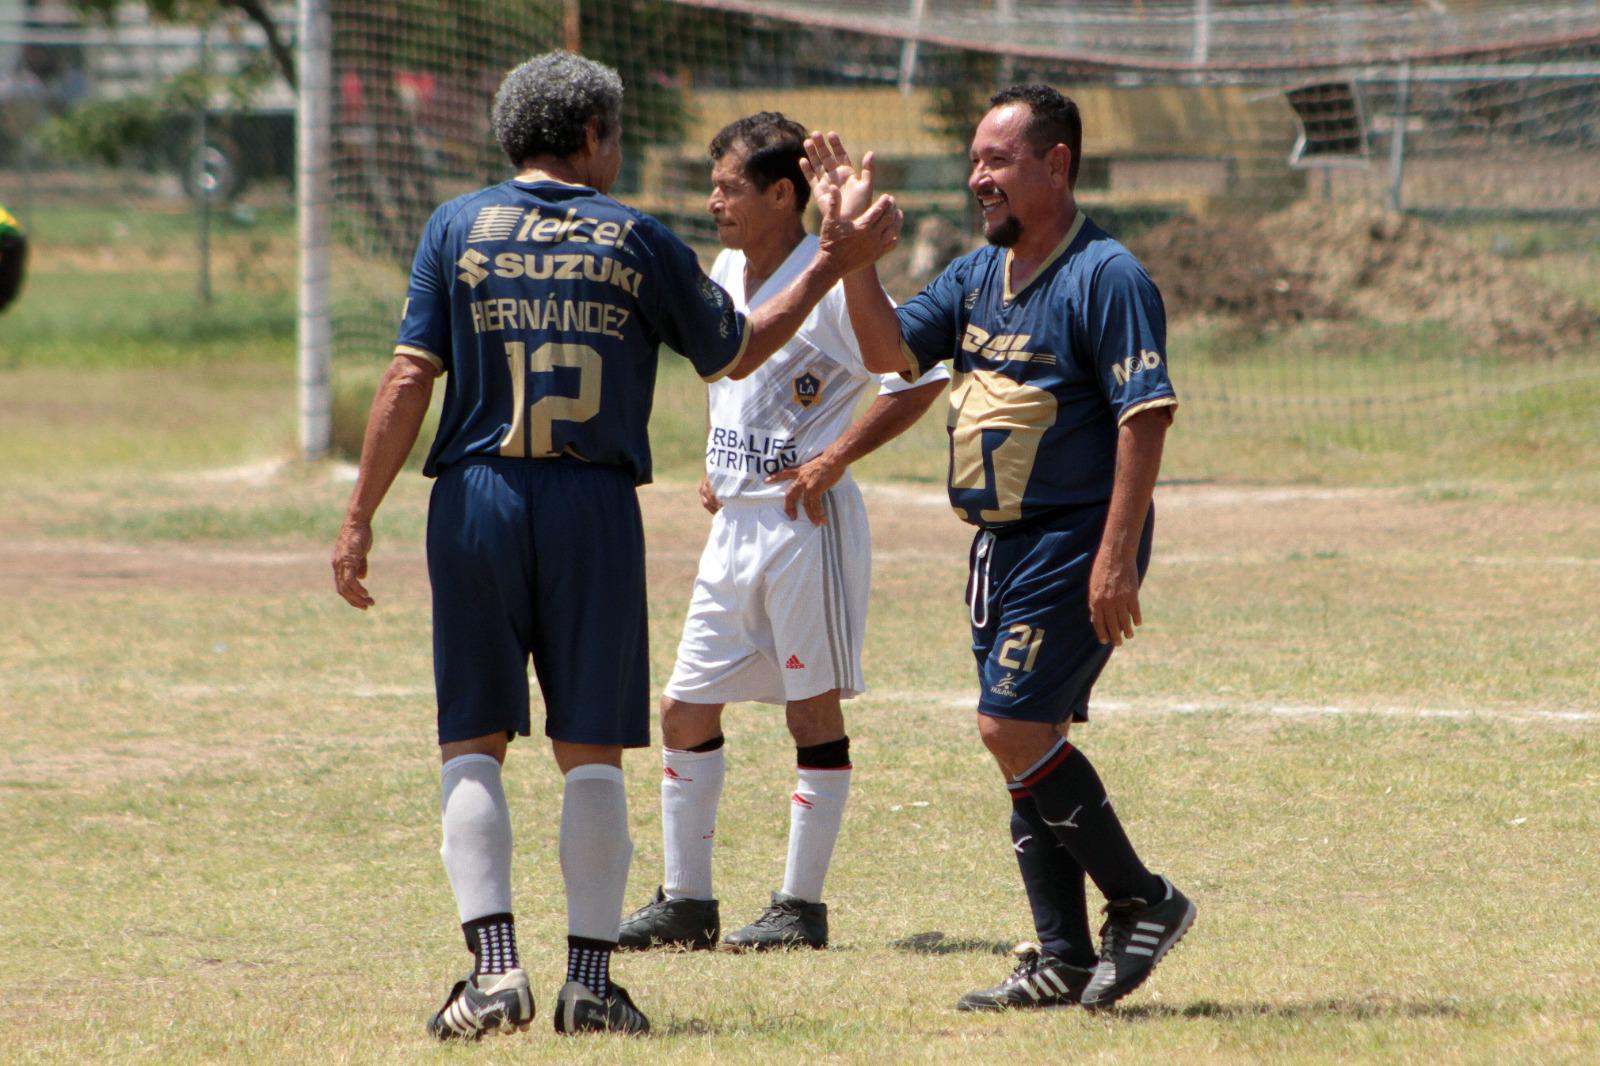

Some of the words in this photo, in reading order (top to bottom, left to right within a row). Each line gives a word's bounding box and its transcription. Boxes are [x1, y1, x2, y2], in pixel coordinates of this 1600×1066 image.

[515, 207, 635, 248] telcel
[493, 251, 644, 299] SUZUKI
[499, 341, 604, 463] 12
[799, 383, 816, 395] LA
[705, 447, 798, 475] TRITION
[711, 427, 796, 455] RBALIFE
[998, 623, 1046, 673] 21
